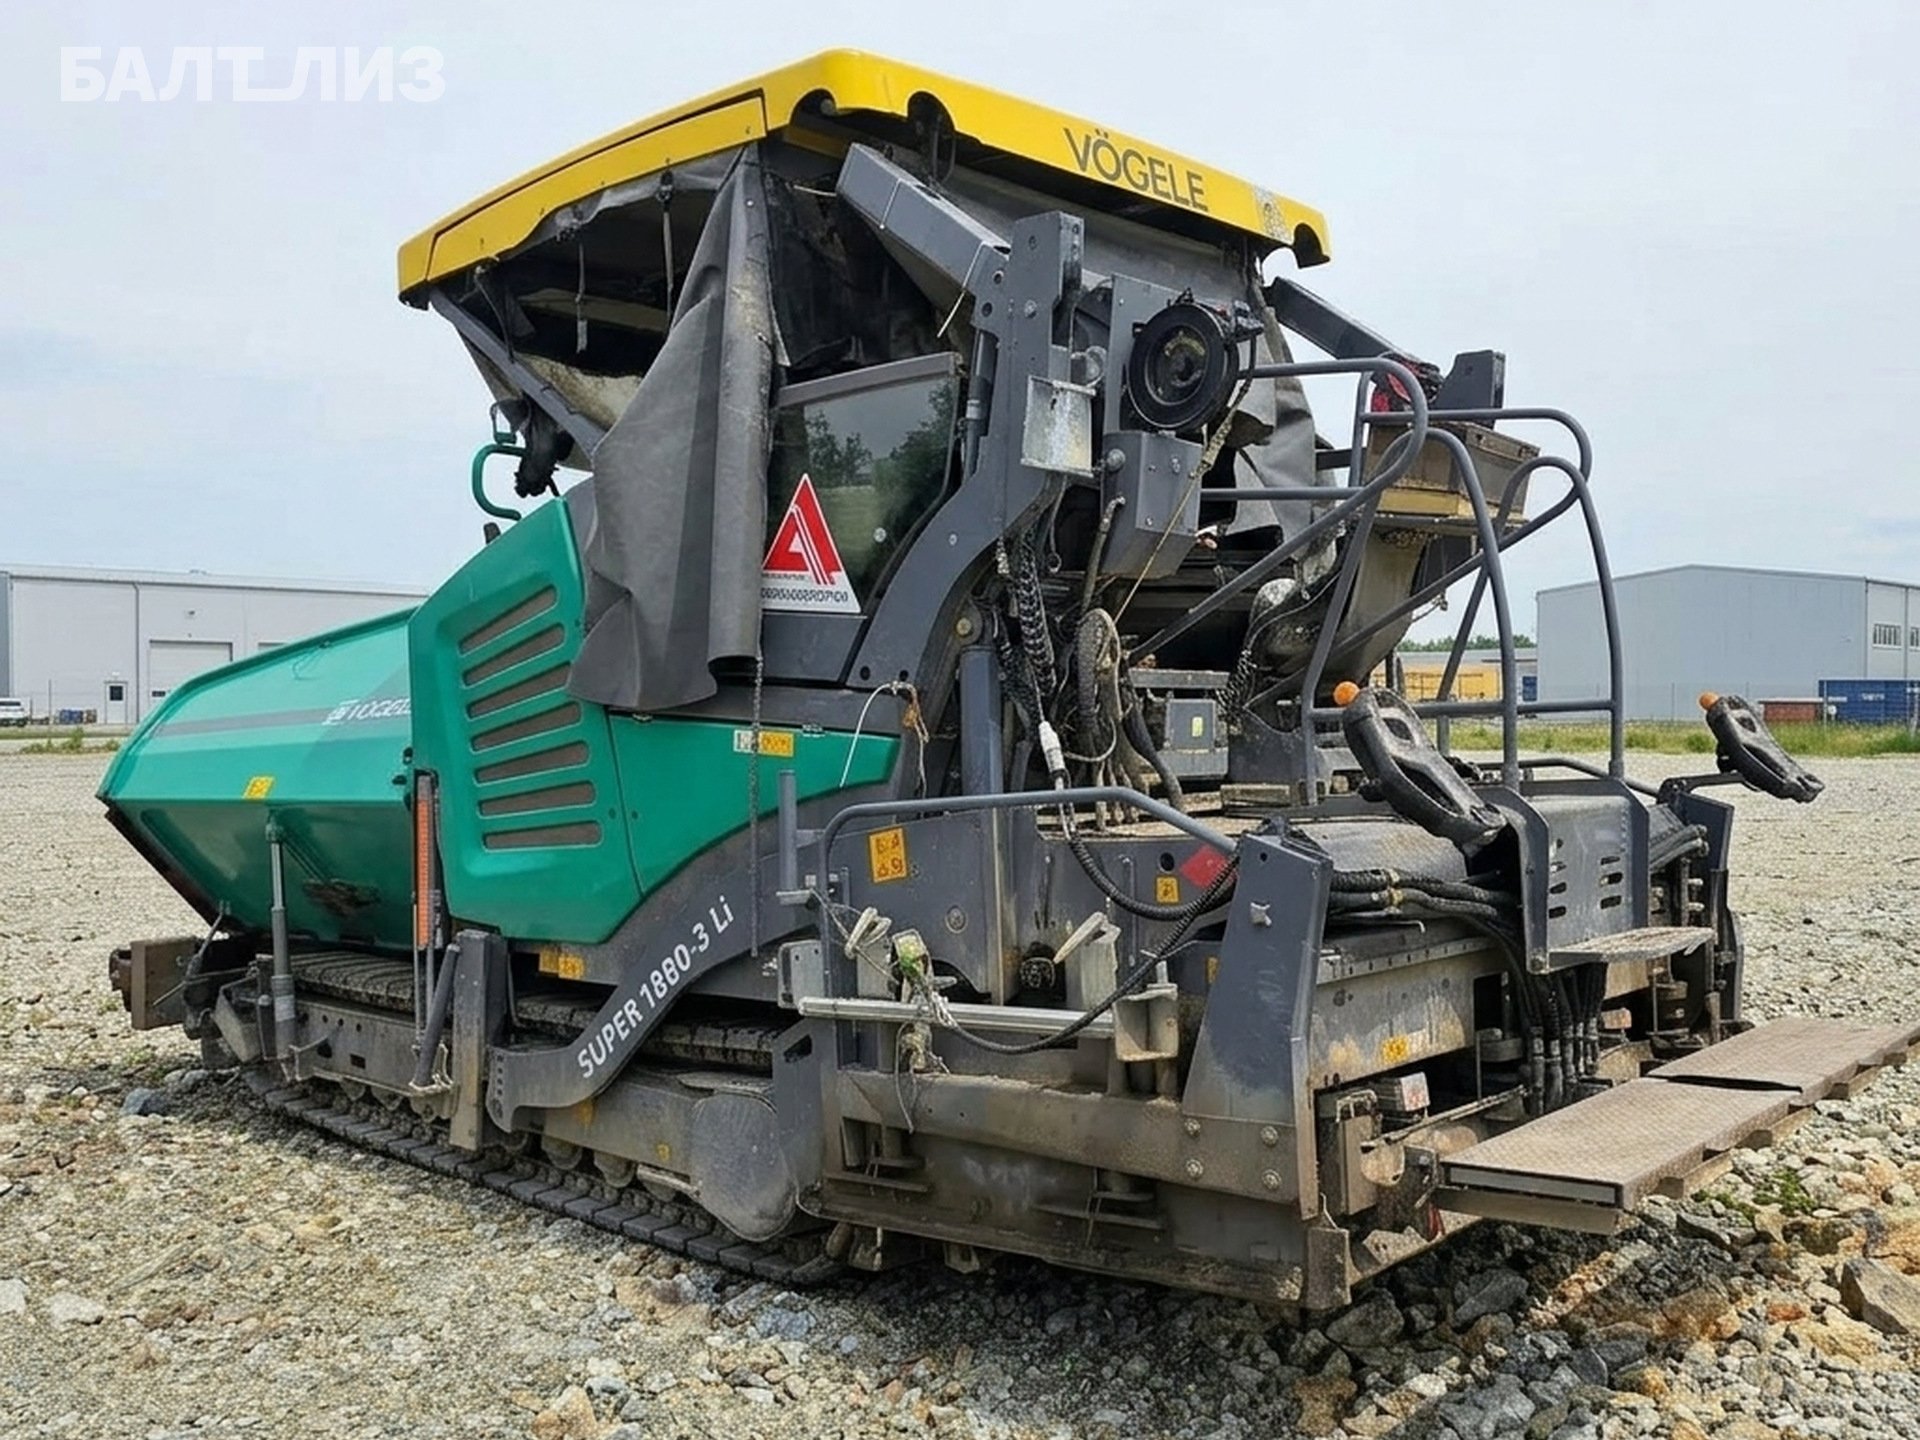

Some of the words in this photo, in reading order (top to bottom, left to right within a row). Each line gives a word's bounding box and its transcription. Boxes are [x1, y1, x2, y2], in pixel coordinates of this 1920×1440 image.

[1063, 127, 1209, 212] VÖGELE
[577, 998, 643, 1079] SUPER
[709, 895, 734, 934] Li
